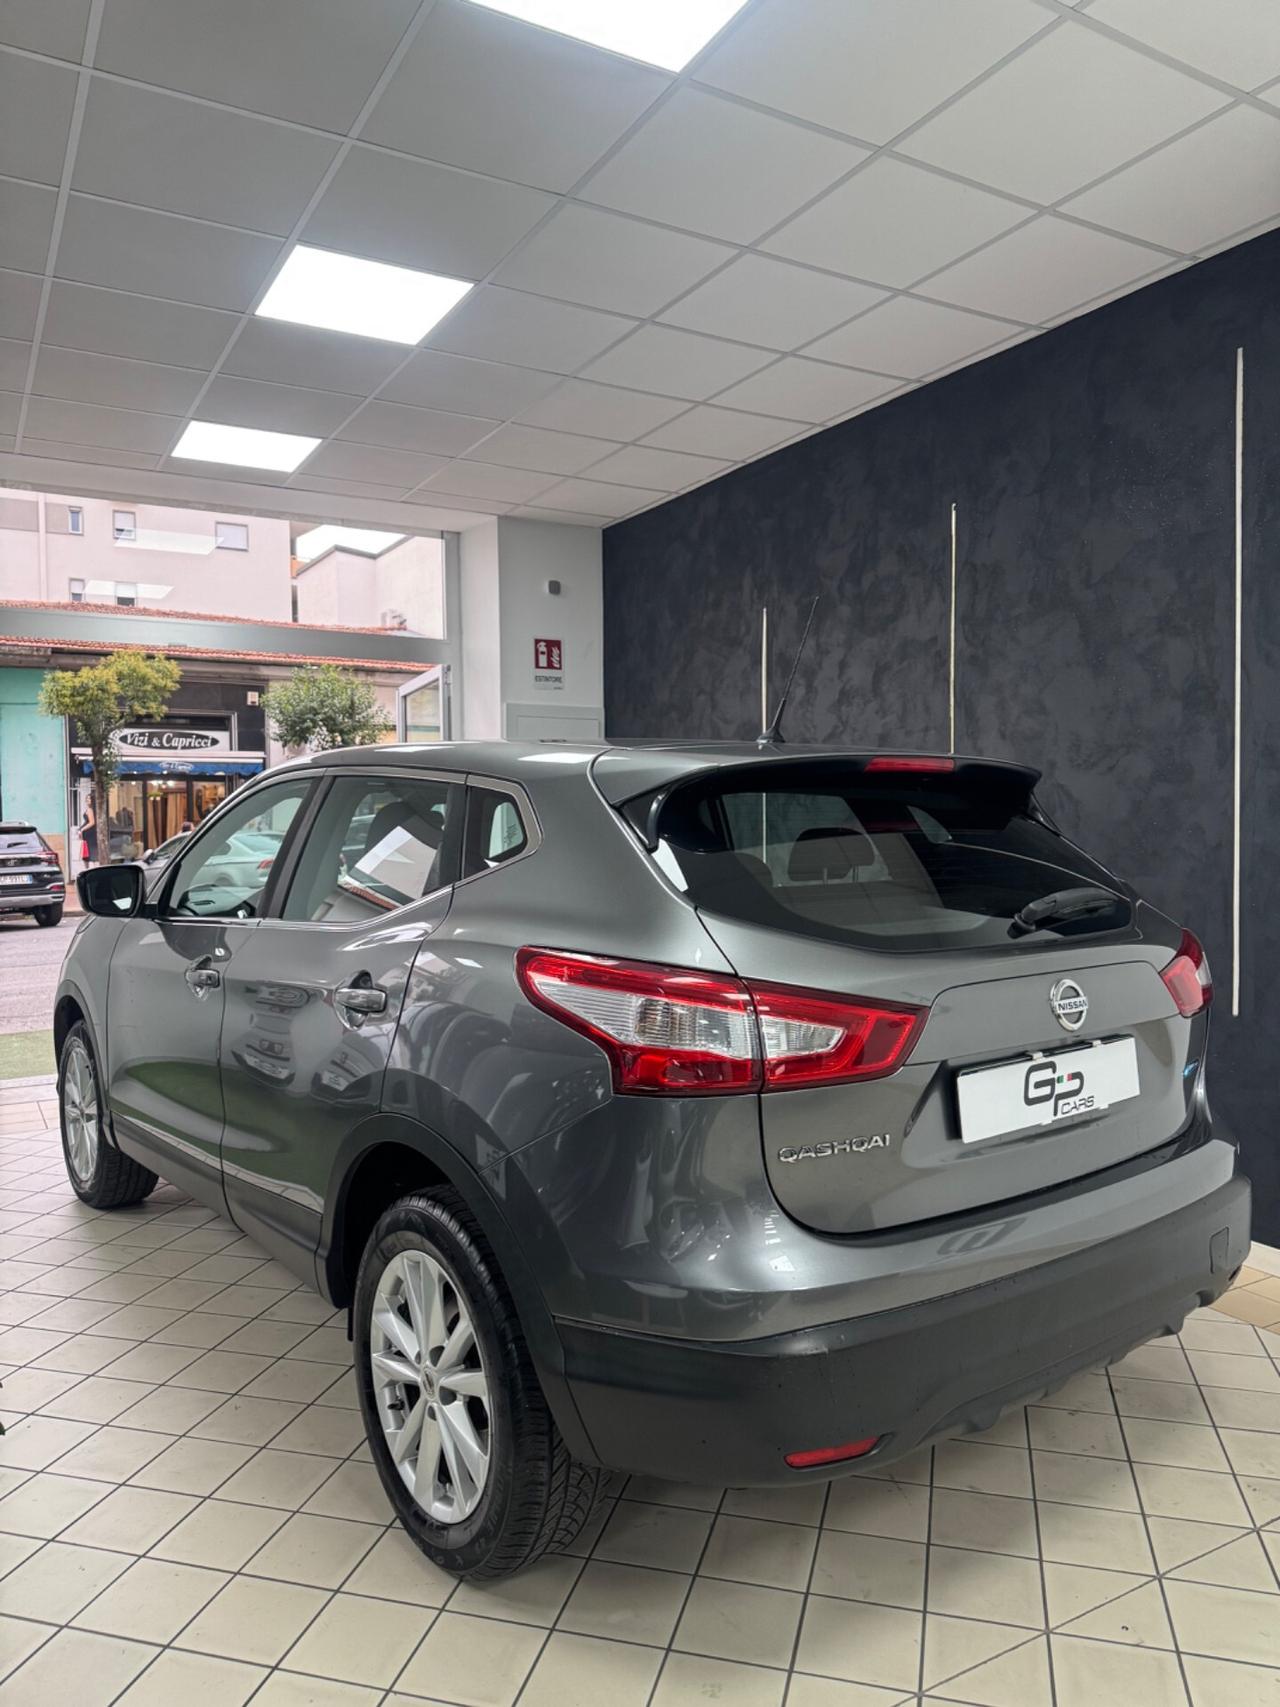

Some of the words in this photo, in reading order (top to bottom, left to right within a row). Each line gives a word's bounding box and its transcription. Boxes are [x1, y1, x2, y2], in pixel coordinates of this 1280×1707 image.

[127, 733, 149, 746] Vizi
[151, 737, 160, 747] &
[162, 733, 212, 750] Capricci
[1058, 999, 1088, 1011] NISSAN
[1060, 1095, 1095, 1116] CARS
[778, 1133, 891, 1163] QASHQAI
